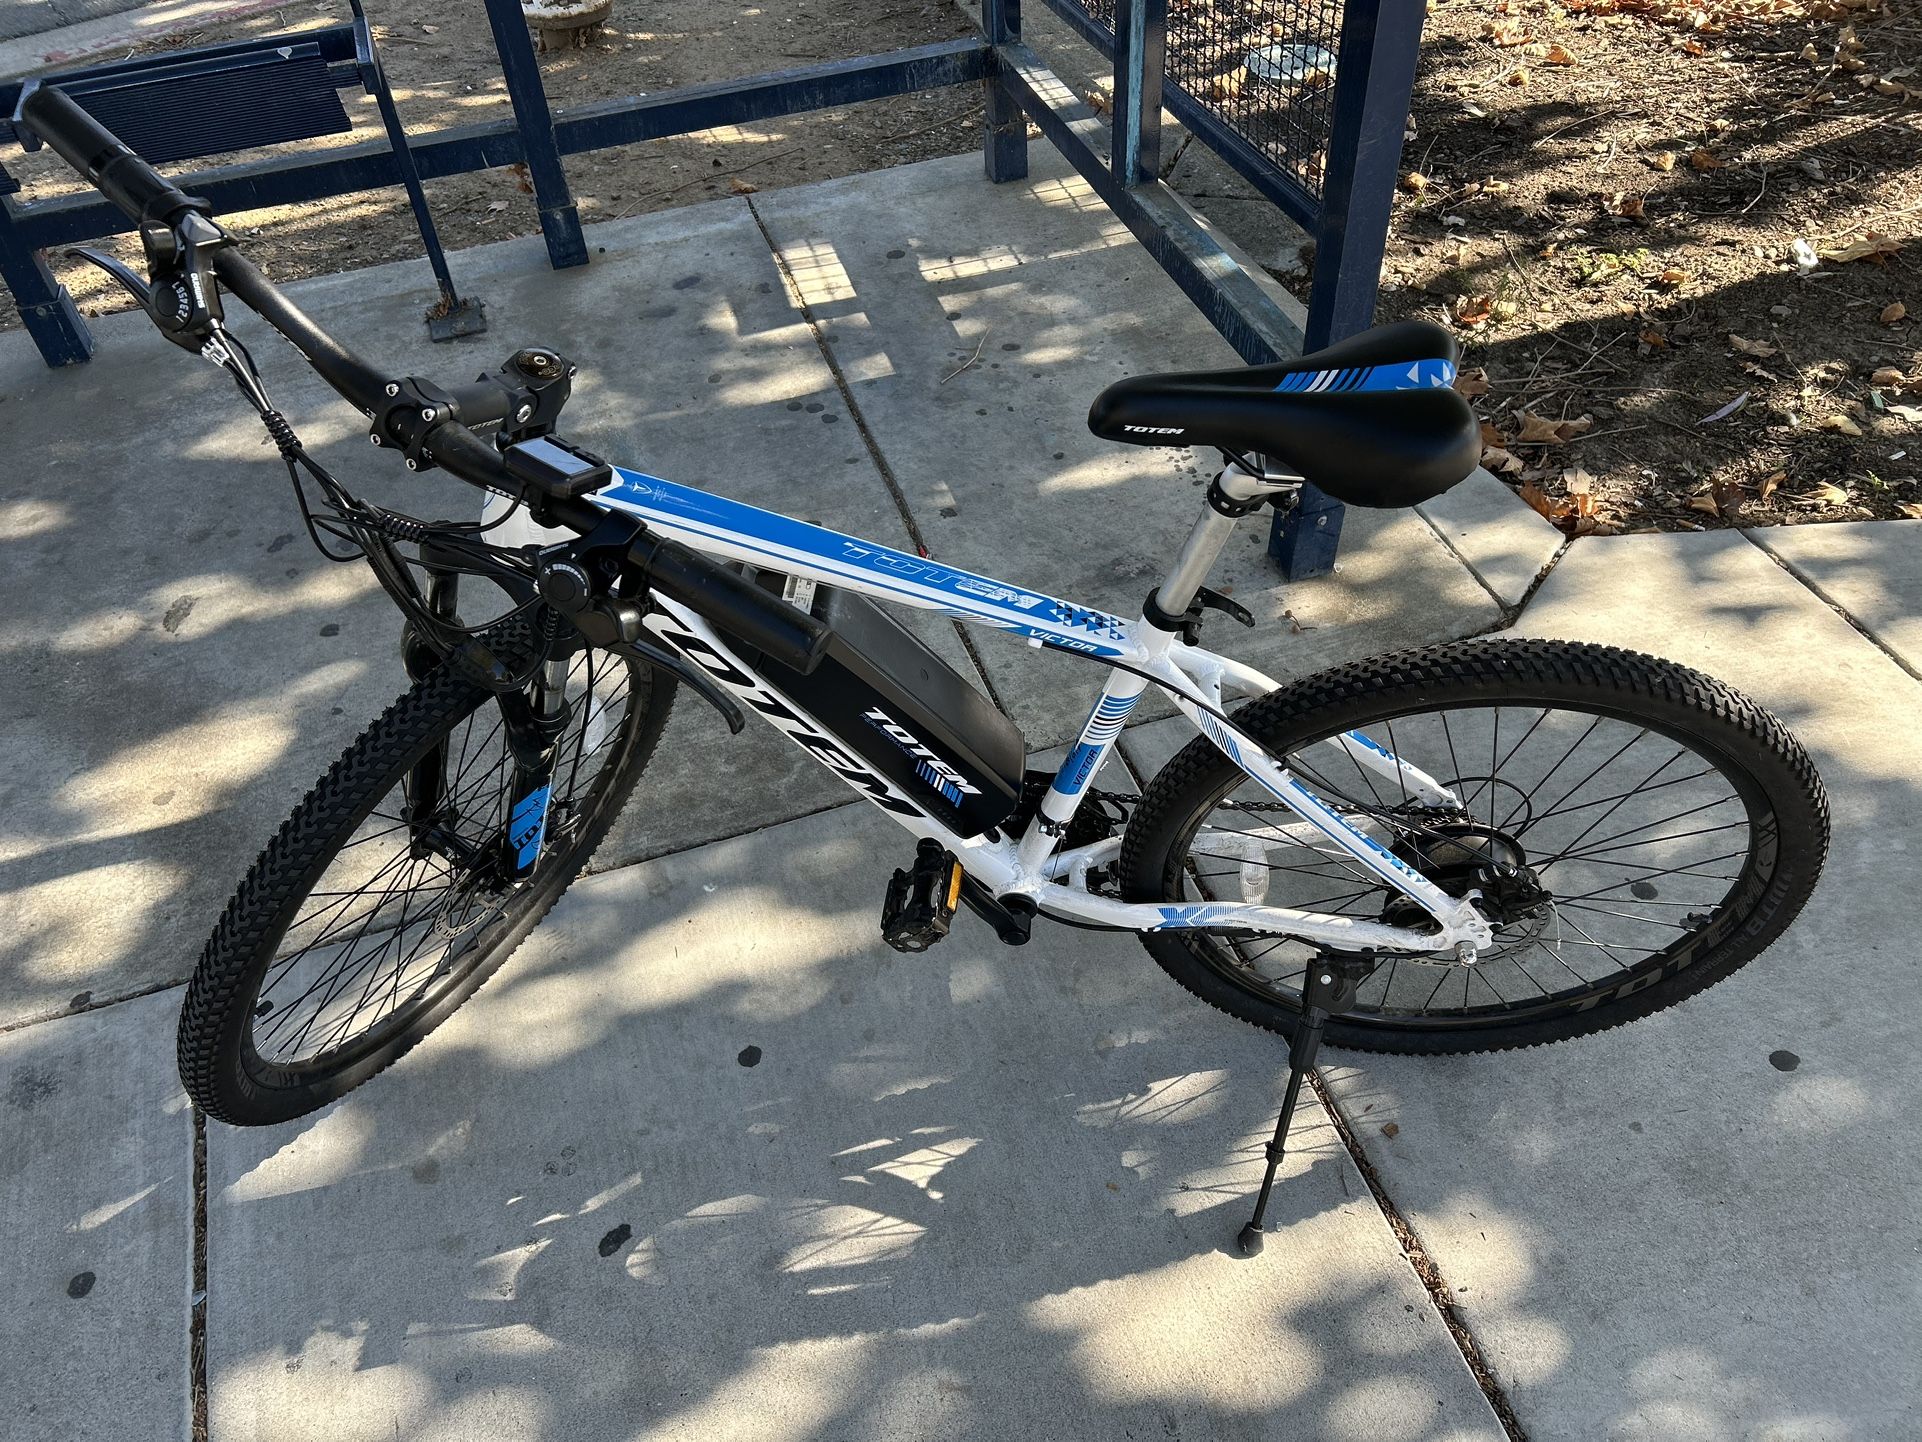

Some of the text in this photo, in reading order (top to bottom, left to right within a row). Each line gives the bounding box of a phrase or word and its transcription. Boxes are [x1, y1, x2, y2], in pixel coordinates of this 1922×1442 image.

[1124, 424, 1185, 435] TOTEM
[843, 542, 1045, 610] TOTEM
[1029, 628, 1098, 652] VICTOR
[859, 712, 918, 760] PERFORMANCE
[864, 706, 983, 795] TOTEM
[1073, 748, 1098, 786] VICTOR
